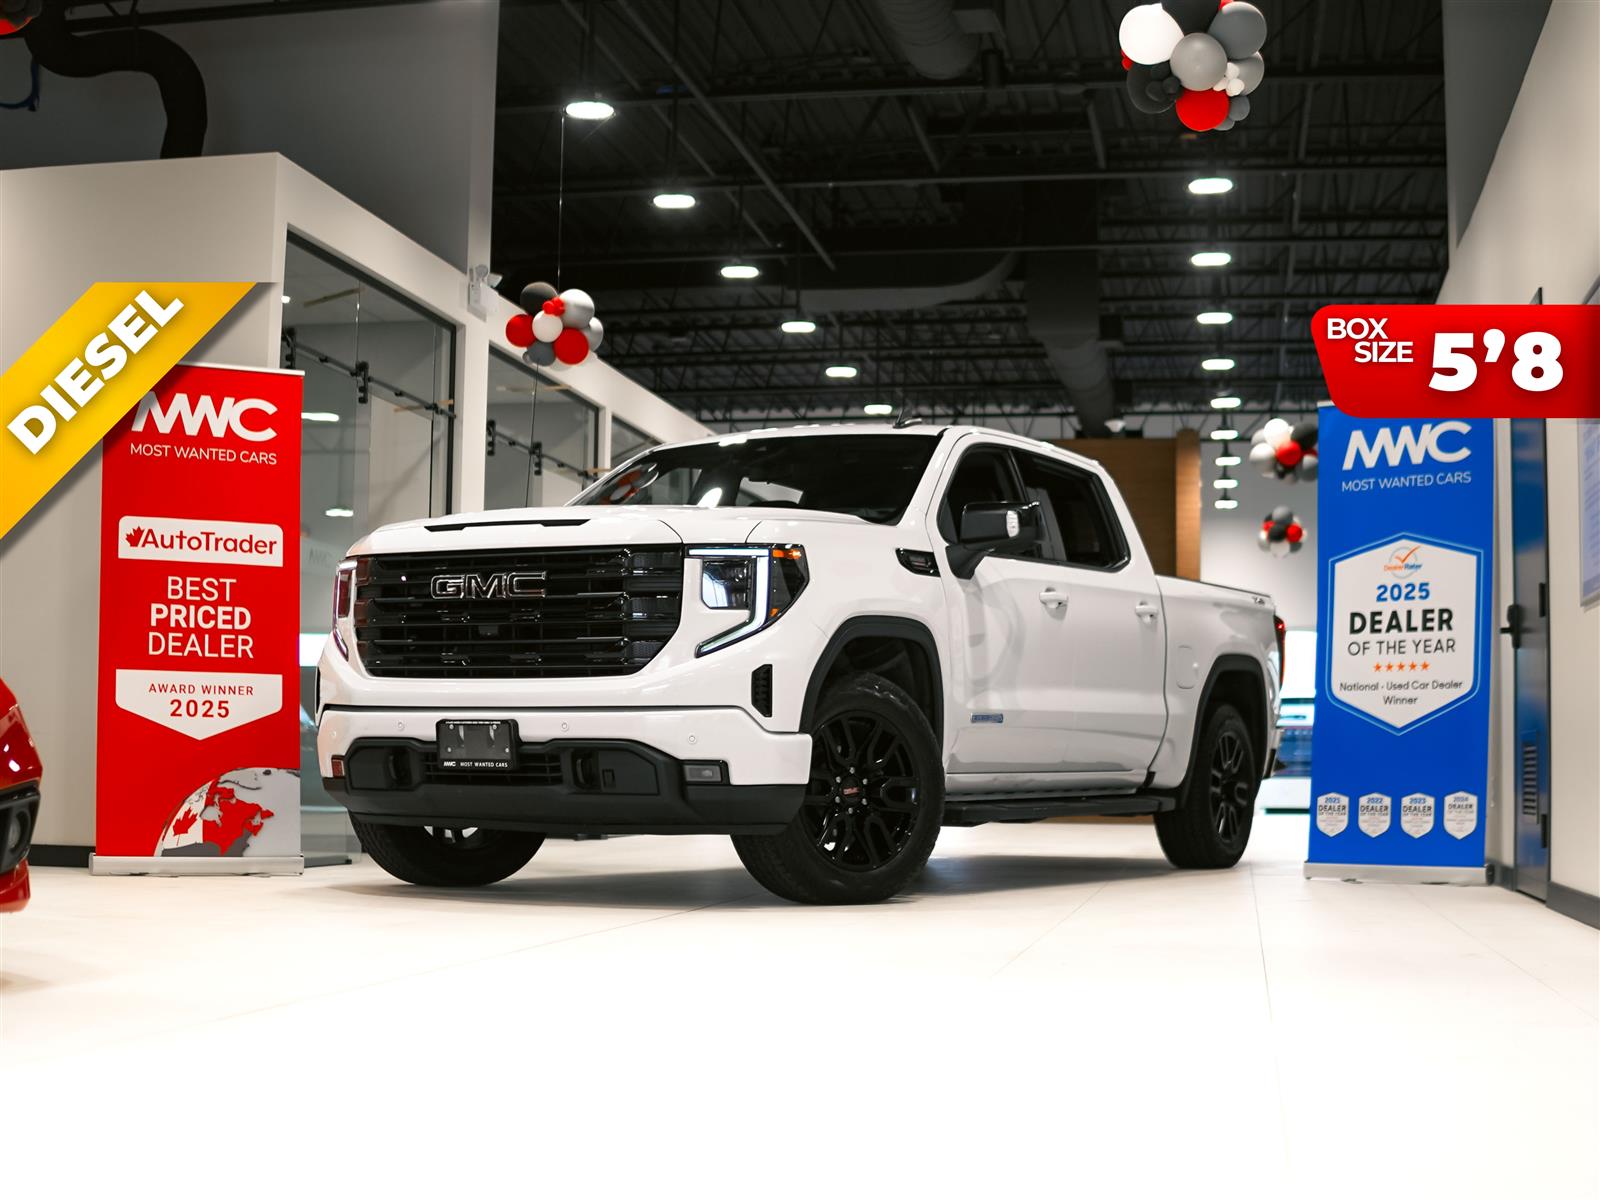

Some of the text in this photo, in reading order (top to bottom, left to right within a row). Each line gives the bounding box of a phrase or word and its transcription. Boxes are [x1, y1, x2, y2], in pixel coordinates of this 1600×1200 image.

[131, 391, 278, 442] MWC
[130, 443, 277, 465] MOST WANTED CARS
[1342, 421, 1472, 471] MWC
[1342, 471, 1471, 492] MOST WANTED CARS
[142, 528, 277, 555] AutoTrader
[167, 575, 236, 602] BEST
[431, 571, 546, 599] GMC
[1376, 582, 1430, 602] 2025
[151, 603, 251, 630] PRICED
[1349, 608, 1454, 635] DEALER
[149, 632, 254, 658] DEALER
[1347, 638, 1456, 656] OF THE YEAR
[149, 683, 254, 696] AWARD WINNER
[1339, 682, 1379, 692] National
[1386, 681, 1410, 691] Used
[1411, 680, 1429, 690] Car
[1432, 679, 1463, 689] Dealer
[170, 699, 230, 719] 2025
[1383, 696, 1418, 705] Winner
[1403, 805, 1432, 813] DEALER
